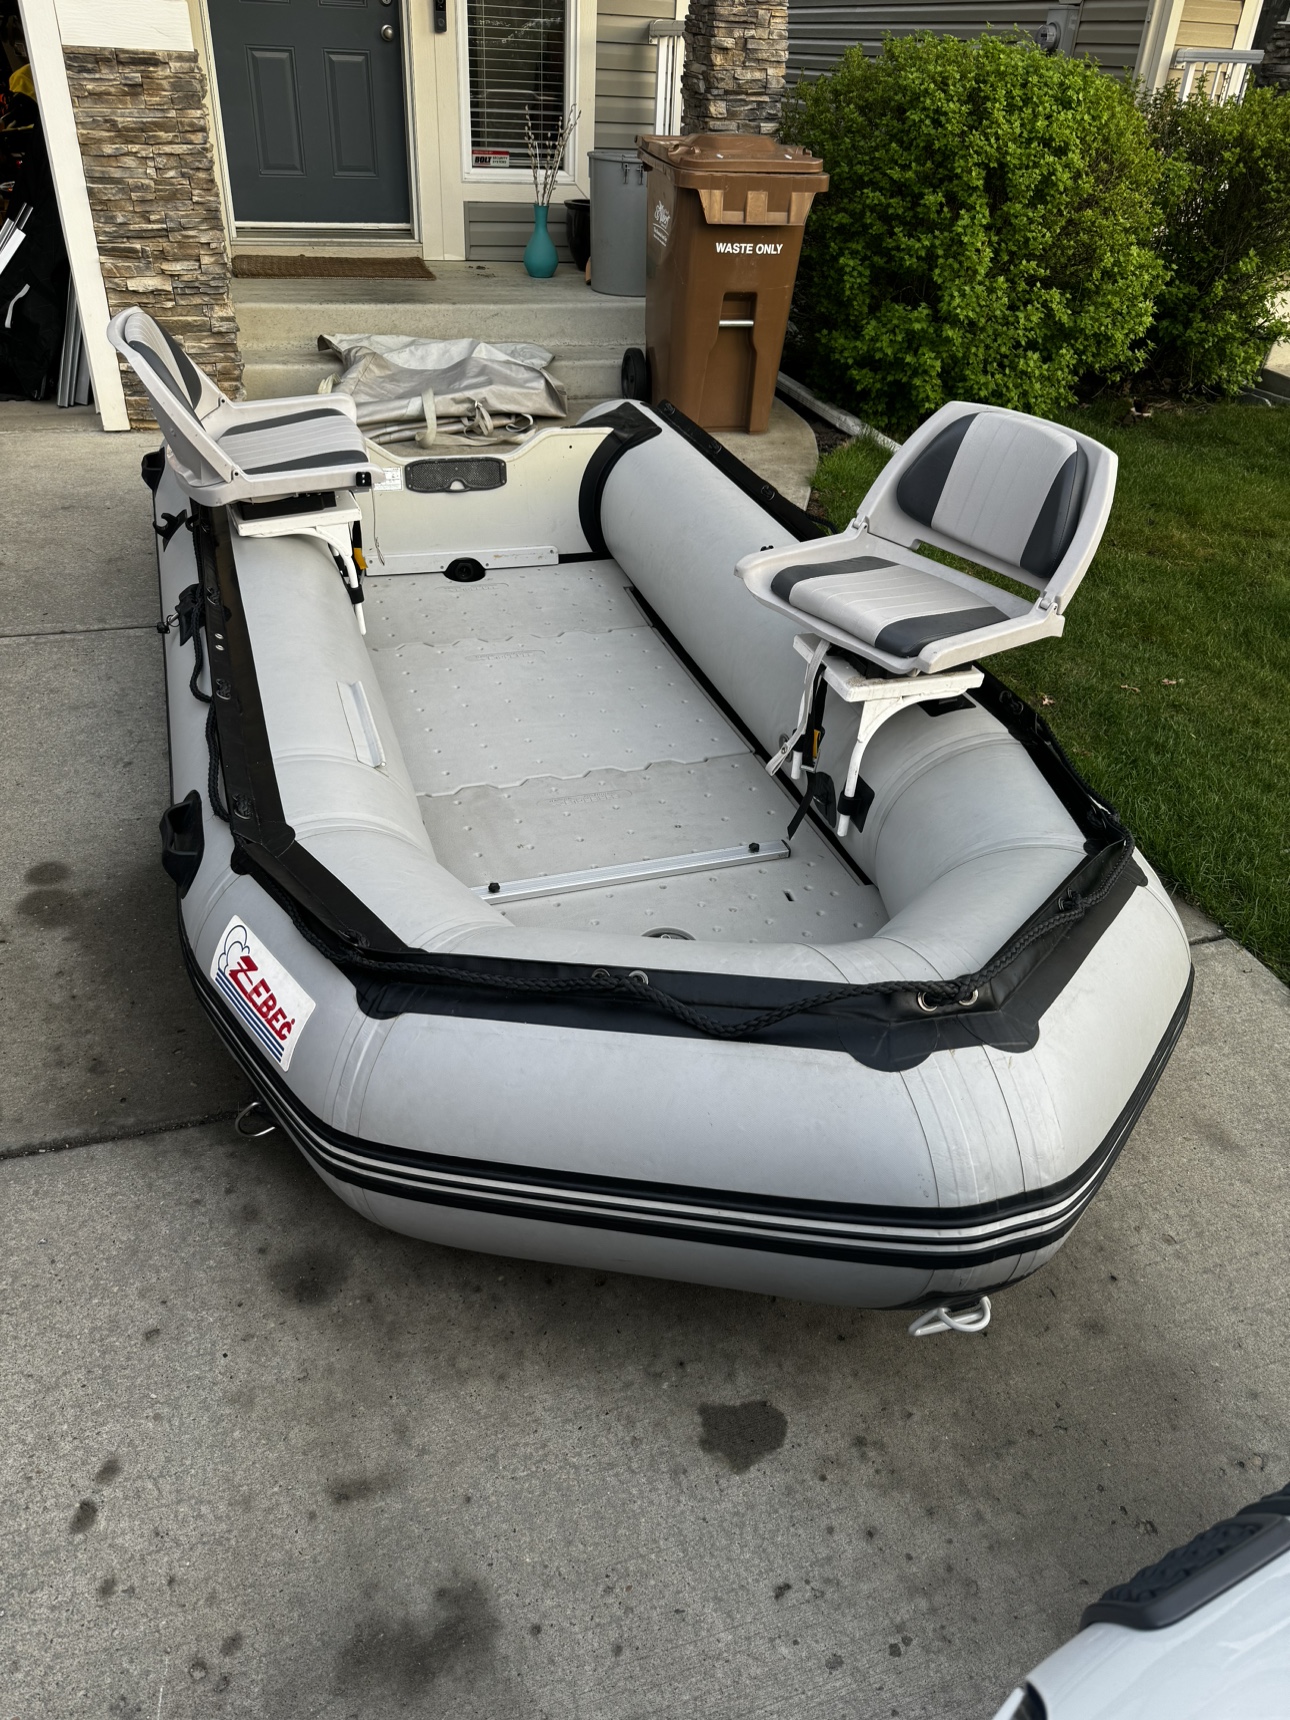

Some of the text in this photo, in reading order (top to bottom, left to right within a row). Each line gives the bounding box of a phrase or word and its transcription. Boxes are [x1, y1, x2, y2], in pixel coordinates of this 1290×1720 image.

[715, 242, 784, 255] WASTE ONLY
[228, 955, 293, 1041] ZEBEC
